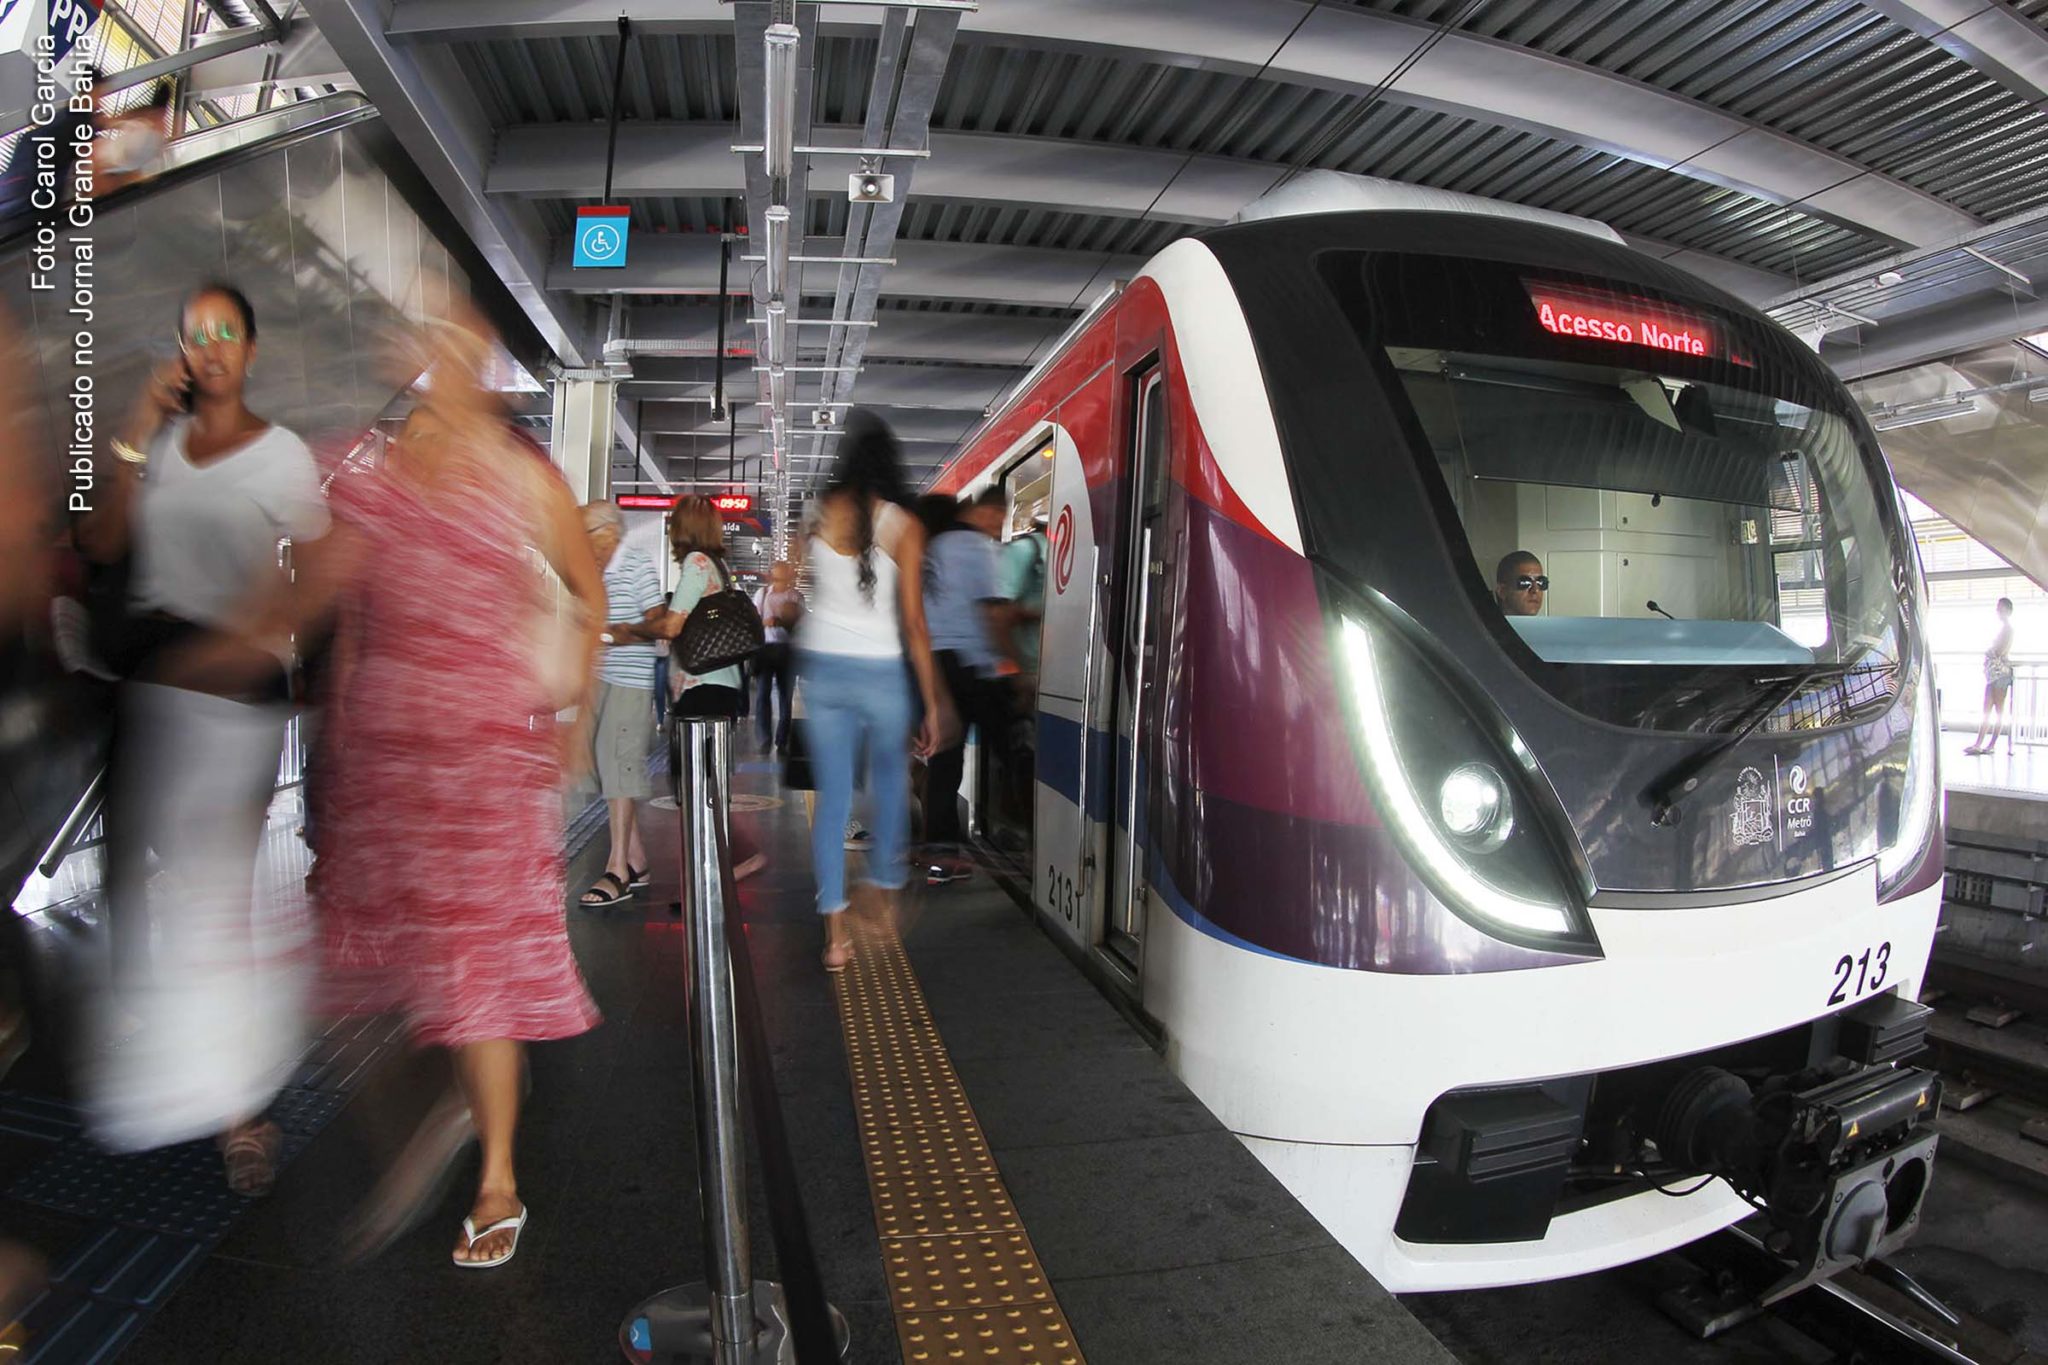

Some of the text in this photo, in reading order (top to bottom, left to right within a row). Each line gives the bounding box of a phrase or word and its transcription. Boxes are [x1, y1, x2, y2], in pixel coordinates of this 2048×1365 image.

[1539, 303, 1705, 357] Acesso Norte
[721, 522, 741, 532] aída
[1787, 798, 1811, 815] CCR
[1787, 816, 1812, 830] Metrô
[1826, 941, 1891, 1007] 213
